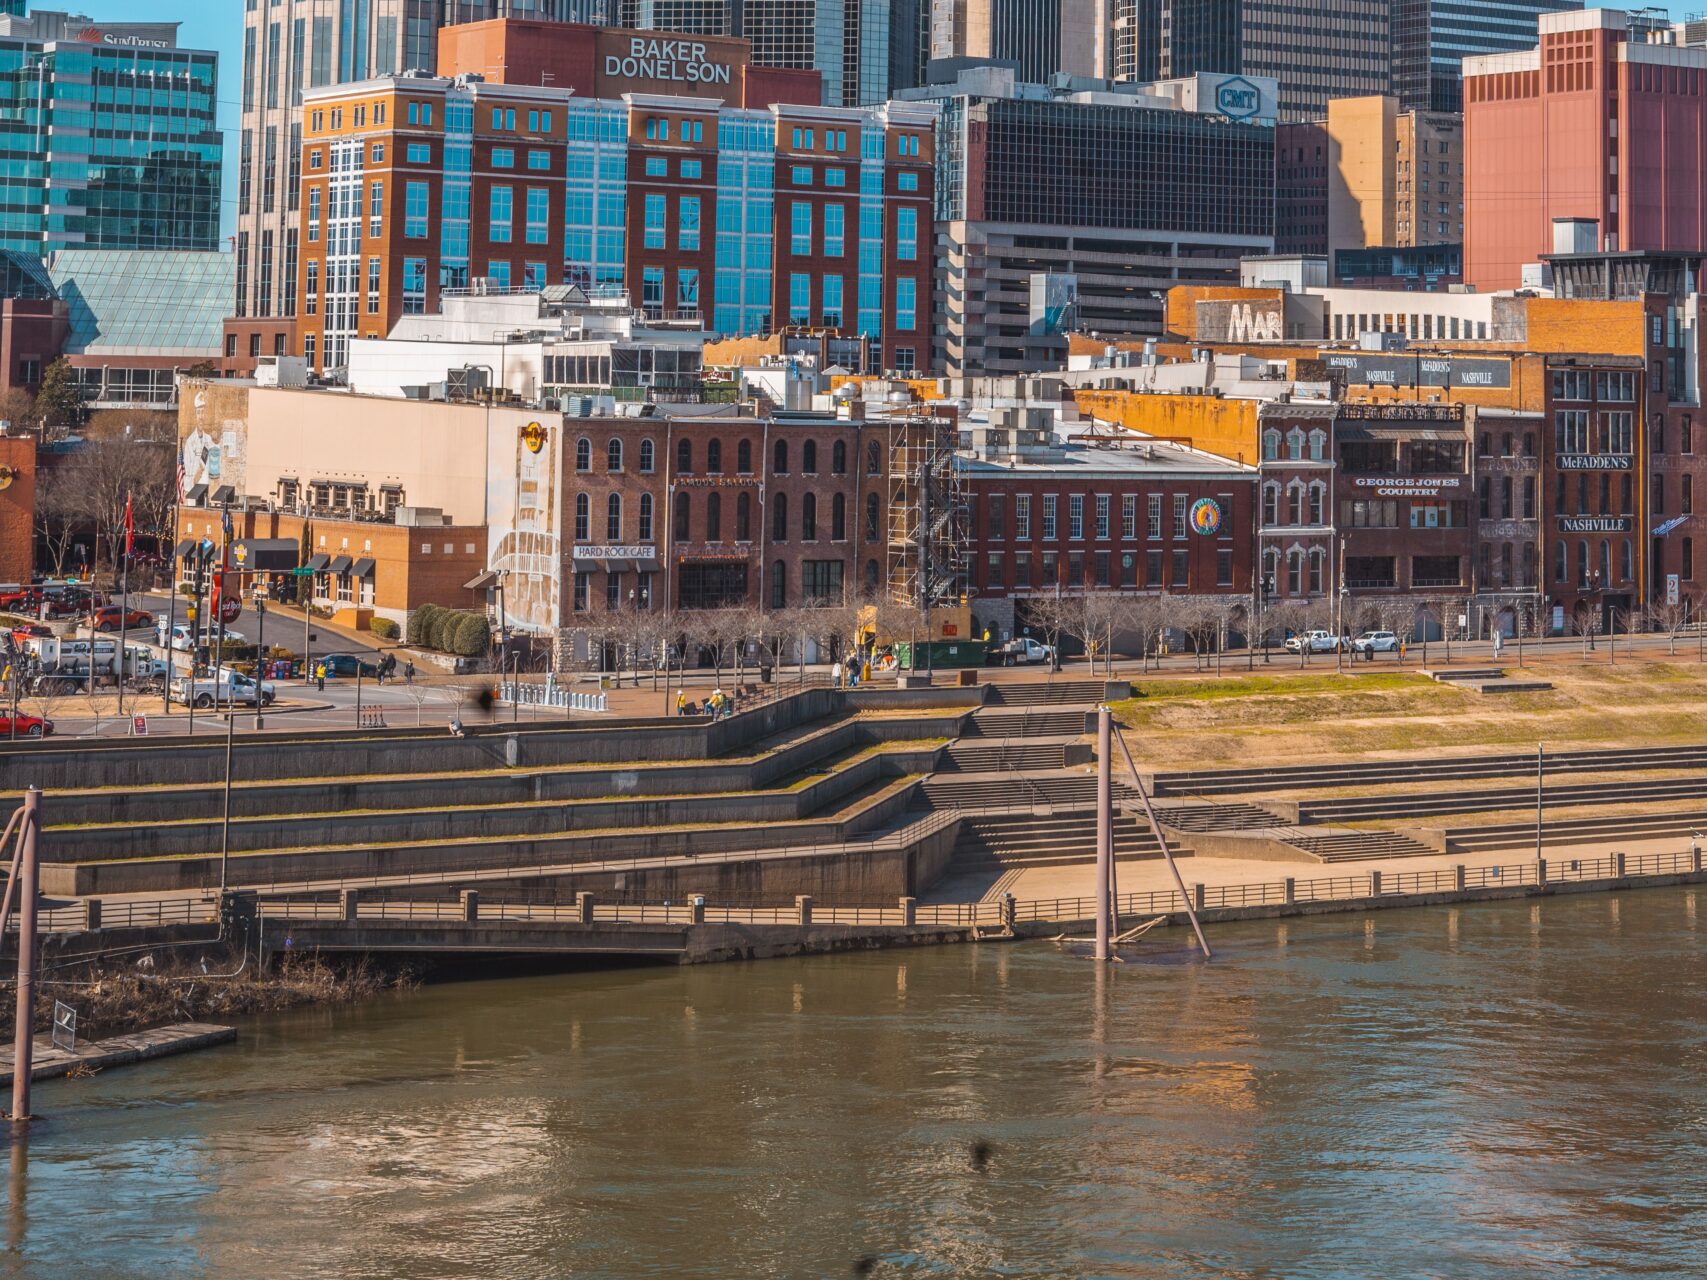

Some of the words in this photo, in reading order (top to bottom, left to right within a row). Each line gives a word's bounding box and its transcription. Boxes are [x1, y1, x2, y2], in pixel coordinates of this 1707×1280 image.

[630, 37, 706, 63] BAKER
[605, 55, 730, 84] DONELSON
[1220, 88, 1256, 109] CMT
[1366, 371, 1395, 382] NASHVILLE
[1461, 372, 1492, 383] NASHVILLE
[1561, 456, 1629, 469] McFADDEN'S
[674, 478, 716, 487] FAMOUS
[1356, 478, 1414, 486] GEORGE
[1416, 478, 1460, 487] JONES
[1377, 488, 1439, 496] COUNTRY
[1564, 519, 1624, 531] NASHVILLE
[579, 547, 602, 557] HARD
[605, 547, 628, 557] ROCK
[630, 547, 652, 557] CAFE
